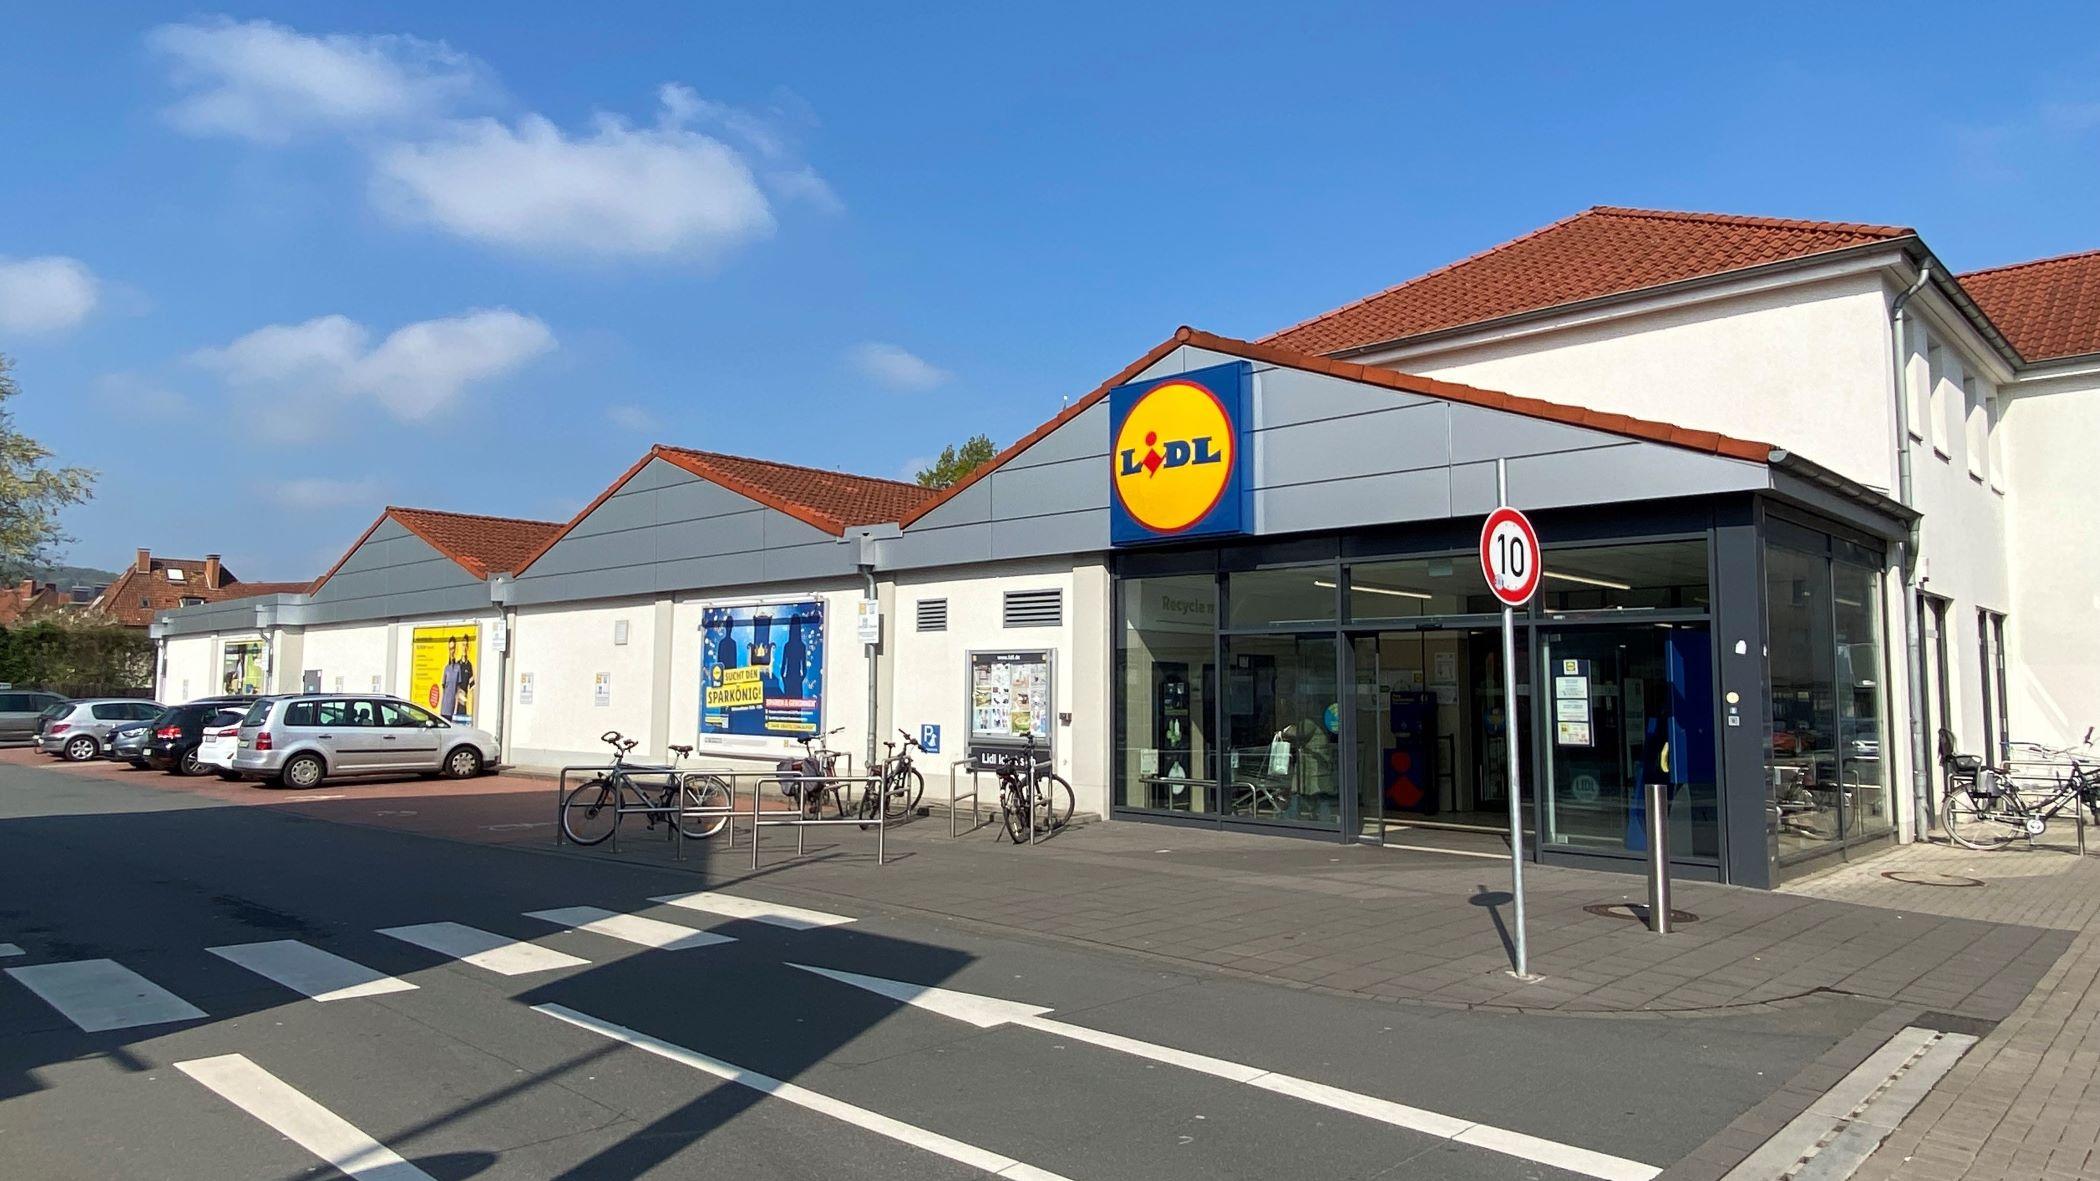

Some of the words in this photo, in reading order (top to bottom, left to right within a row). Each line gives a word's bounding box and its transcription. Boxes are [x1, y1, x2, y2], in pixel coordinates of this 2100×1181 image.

[1498, 533, 1524, 577] 10
[1161, 595, 1205, 615] Recycle
[725, 670, 744, 681] SUCHT
[746, 669, 758, 679] DEN
[708, 686, 761, 704] SPARKÖNIG!
[924, 726, 934, 742] P
[982, 753, 996, 764] Lidl
